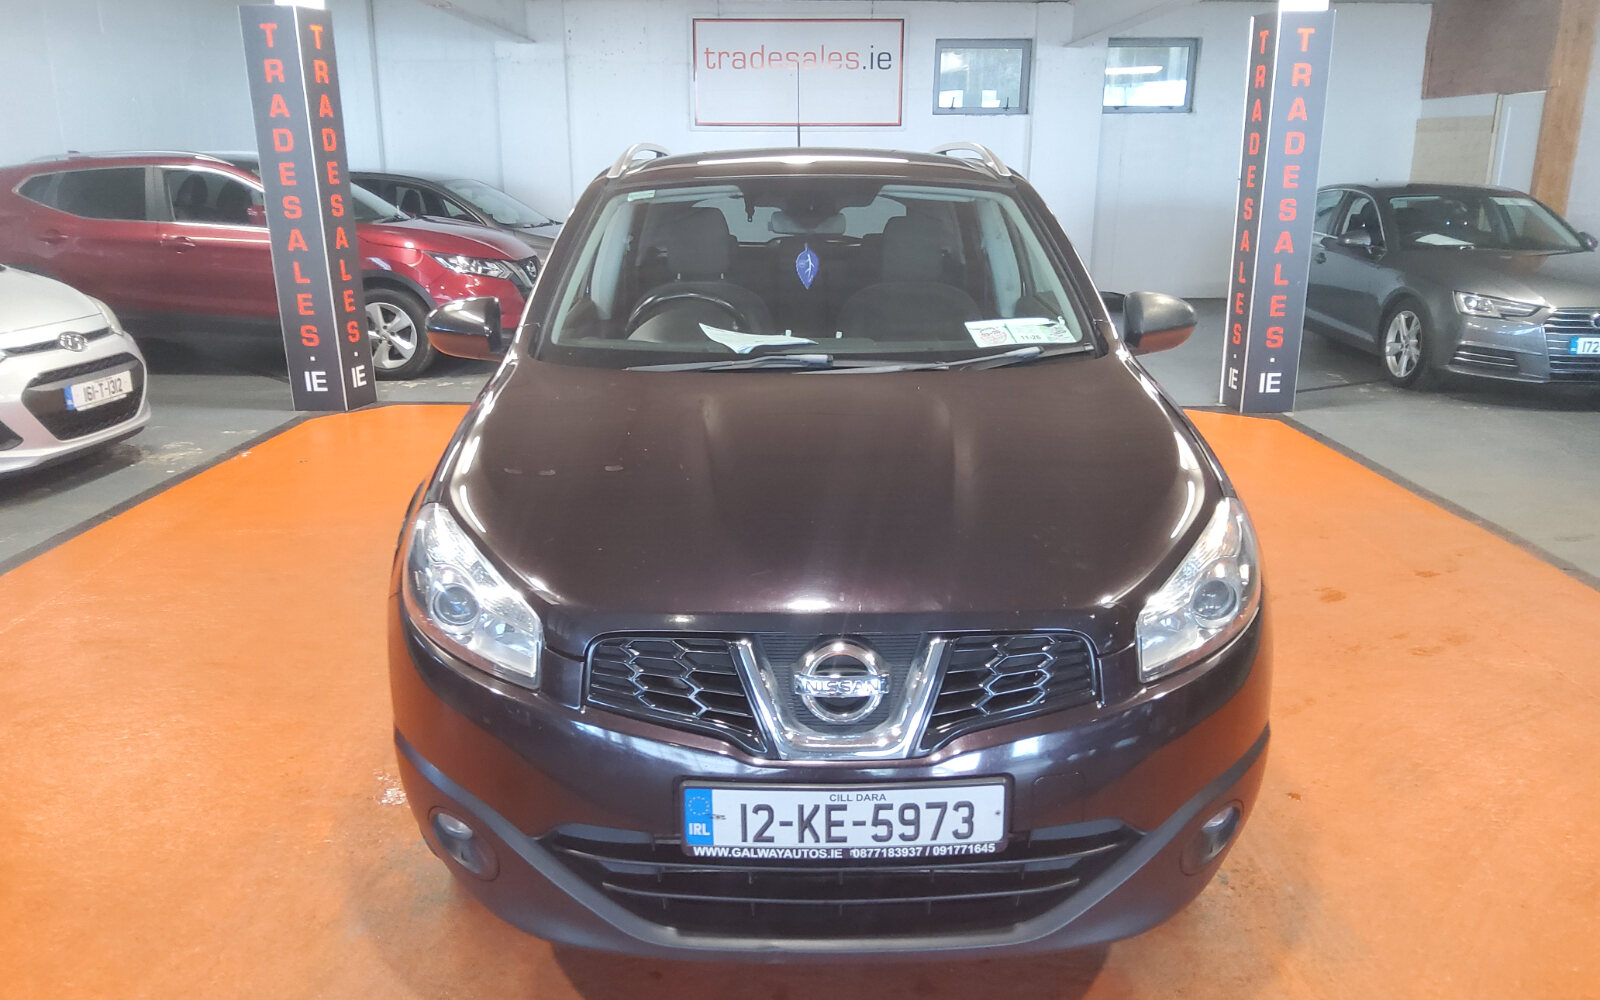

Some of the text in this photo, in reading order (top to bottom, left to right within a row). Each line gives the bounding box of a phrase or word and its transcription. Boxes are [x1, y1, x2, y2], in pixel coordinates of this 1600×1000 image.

[704, 44, 892, 70] tradesales.ie
[83, 377, 124, 402] 161-T-1312
[803, 679, 881, 695] NISSAN
[829, 793, 887, 802] CILL DARA
[688, 822, 711, 836] IRL
[740, 800, 975, 844] 12-KE-5973
[693, 846, 843, 859] WWW.GALWAYAUTOS.IE
[853, 846, 923, 859] 0877183937
[932, 843, 996, 856] 091771645
